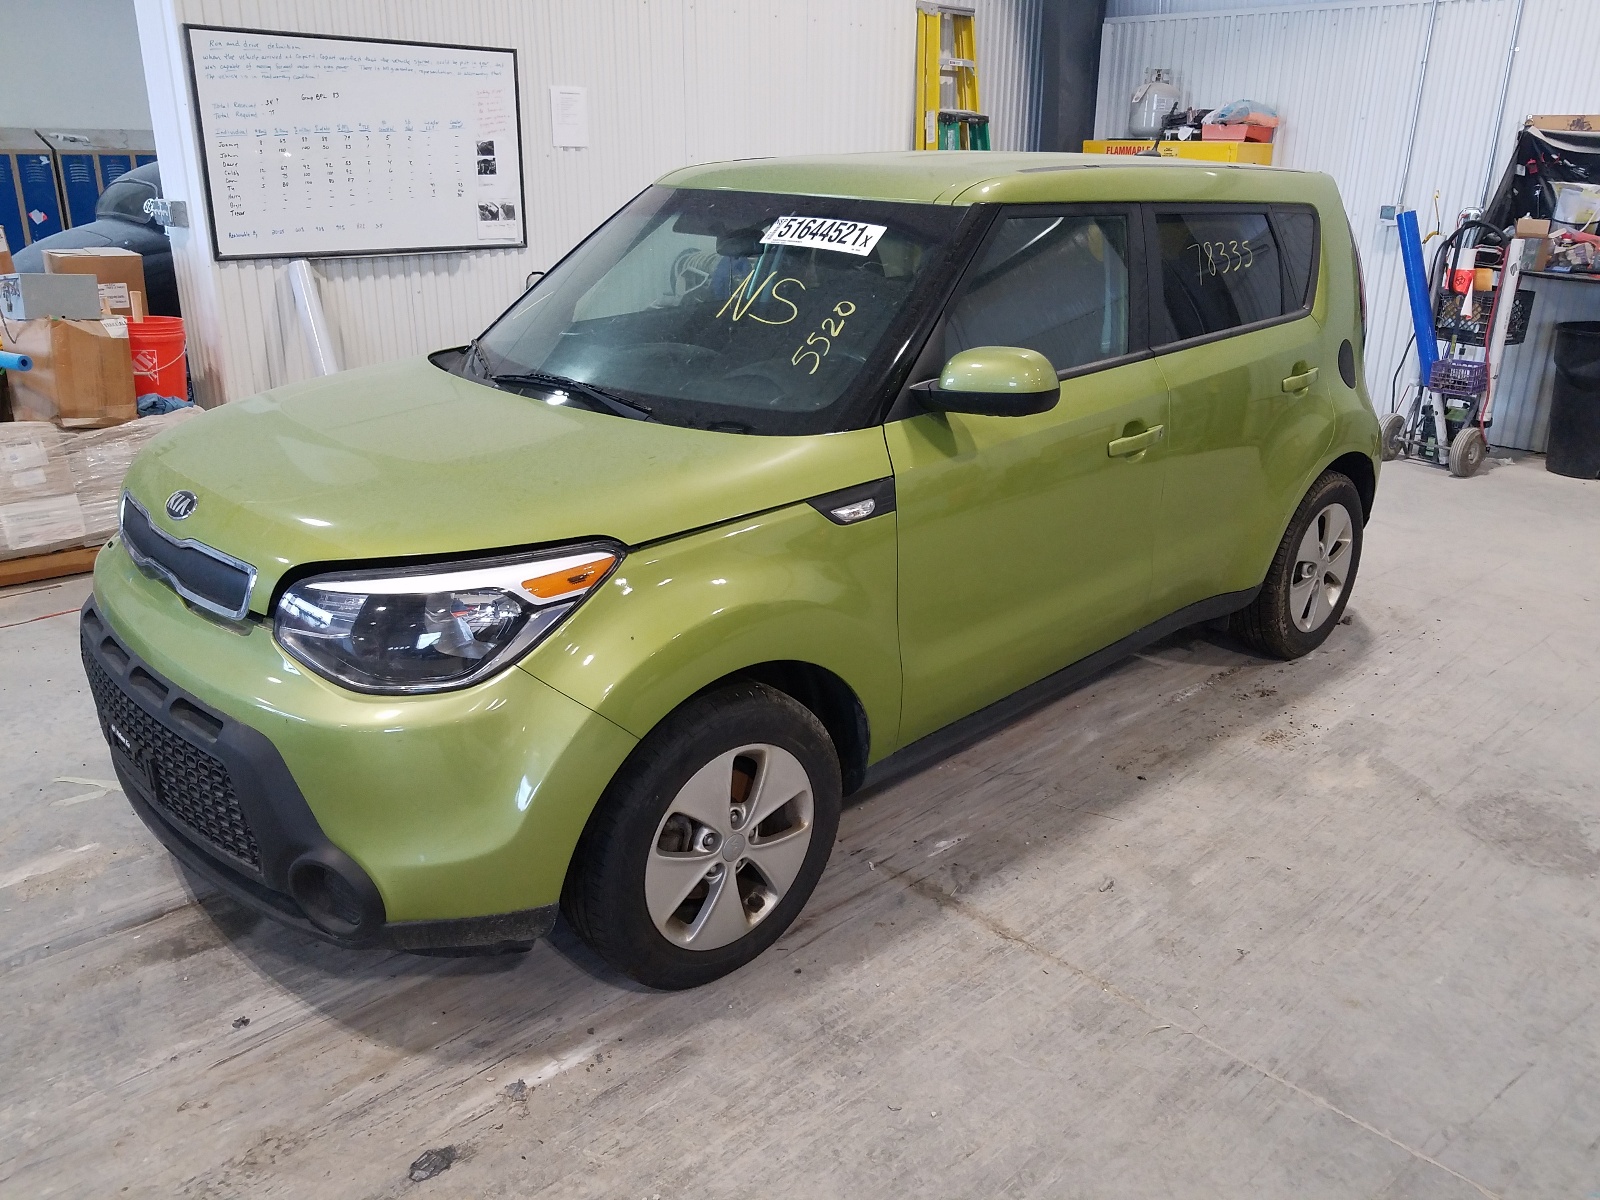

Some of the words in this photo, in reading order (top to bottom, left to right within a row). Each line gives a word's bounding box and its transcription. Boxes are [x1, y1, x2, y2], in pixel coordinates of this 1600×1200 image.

[777, 218, 869, 246] 51644521
[1186, 240, 1253, 286] 78335
[716, 269, 806, 325] NS
[791, 301, 856, 375] 5520
[167, 491, 191, 516] KIA
